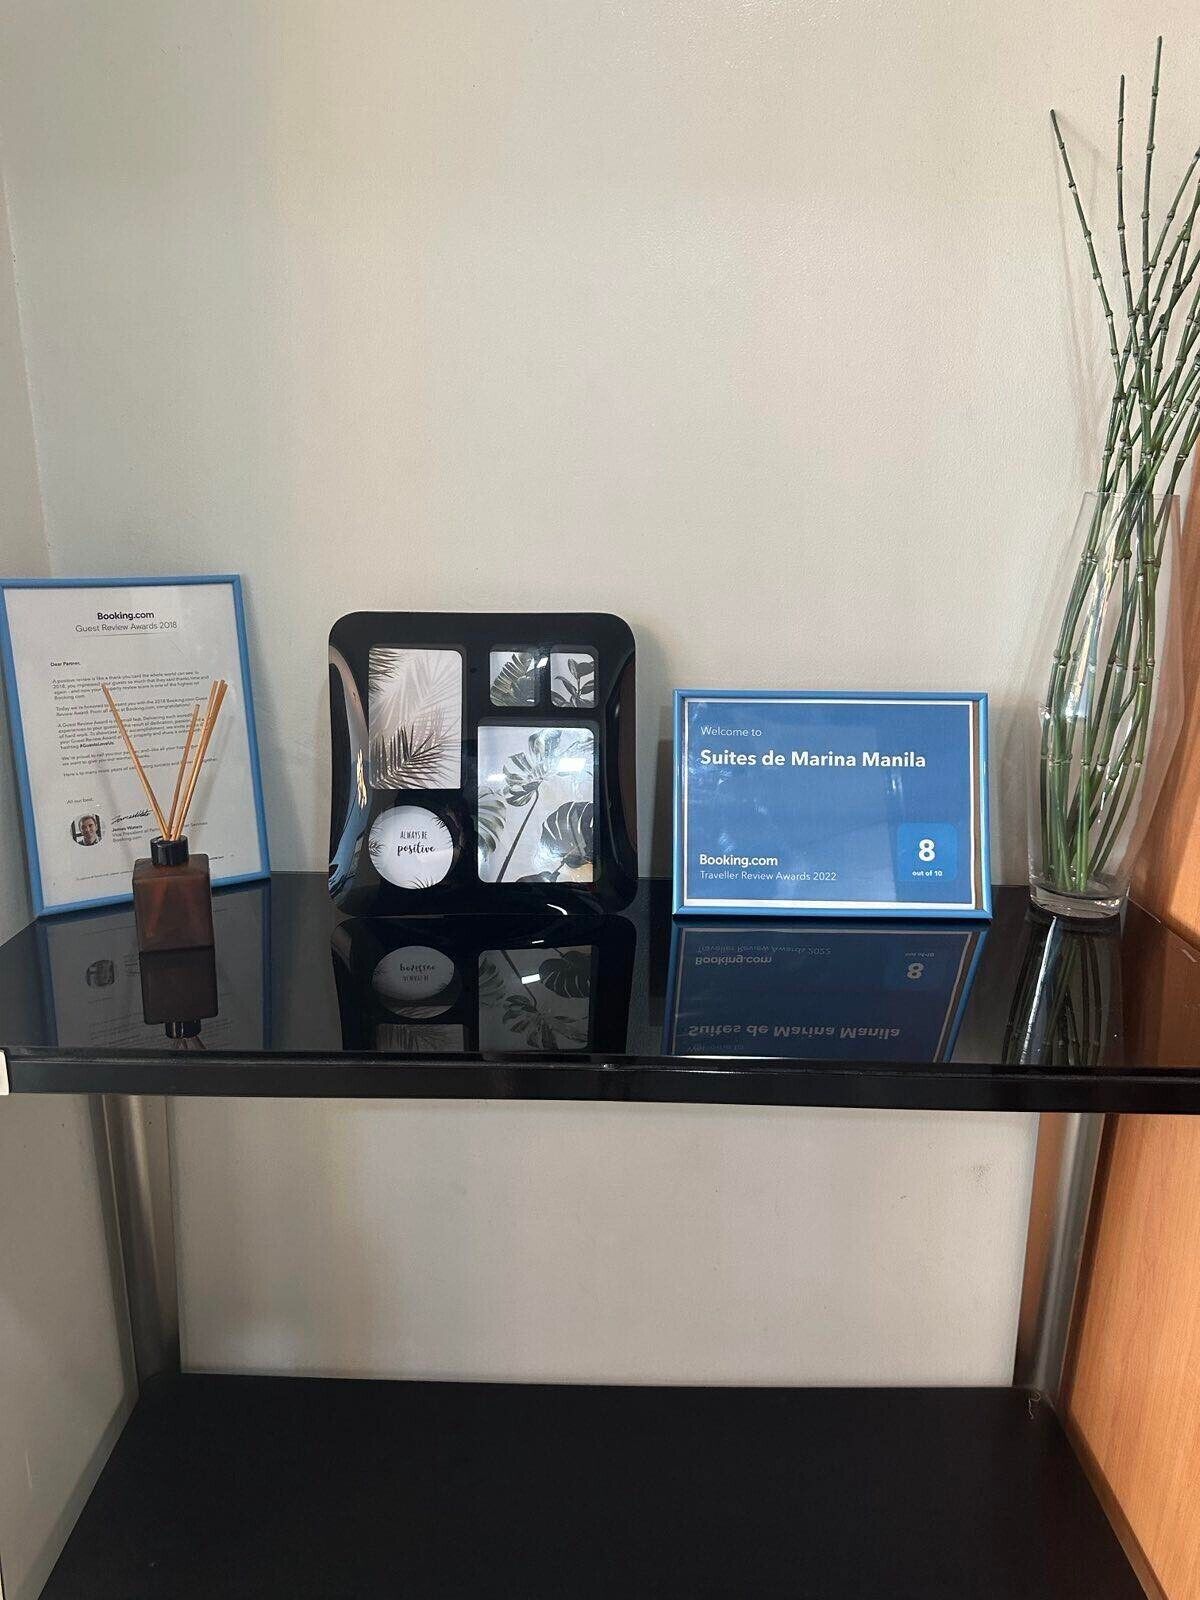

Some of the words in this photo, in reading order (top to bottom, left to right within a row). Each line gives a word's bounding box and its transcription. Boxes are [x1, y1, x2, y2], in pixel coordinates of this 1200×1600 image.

[97, 611, 155, 621] Booking.com
[75, 624, 100, 632] Guest
[101, 623, 129, 631] Review
[130, 622, 158, 630] Awards
[159, 621, 178, 629] 2018
[700, 726, 749, 737] Welcome
[751, 727, 763, 737] to
[700, 749, 757, 766] Suites
[762, 750, 786, 766] de
[791, 751, 857, 767] Marina
[862, 752, 926, 768] Manila
[399, 830, 421, 840] ALWAYS
[421, 831, 428, 840] BE
[397, 841, 436, 857] positive
[918, 838, 936, 862] 8
[699, 854, 778, 868] Booking.com
[700, 870, 739, 880] Traveller
[741, 871, 774, 880] Review
[775, 871, 811, 881] Awards
[813, 871, 837, 881] 2022
